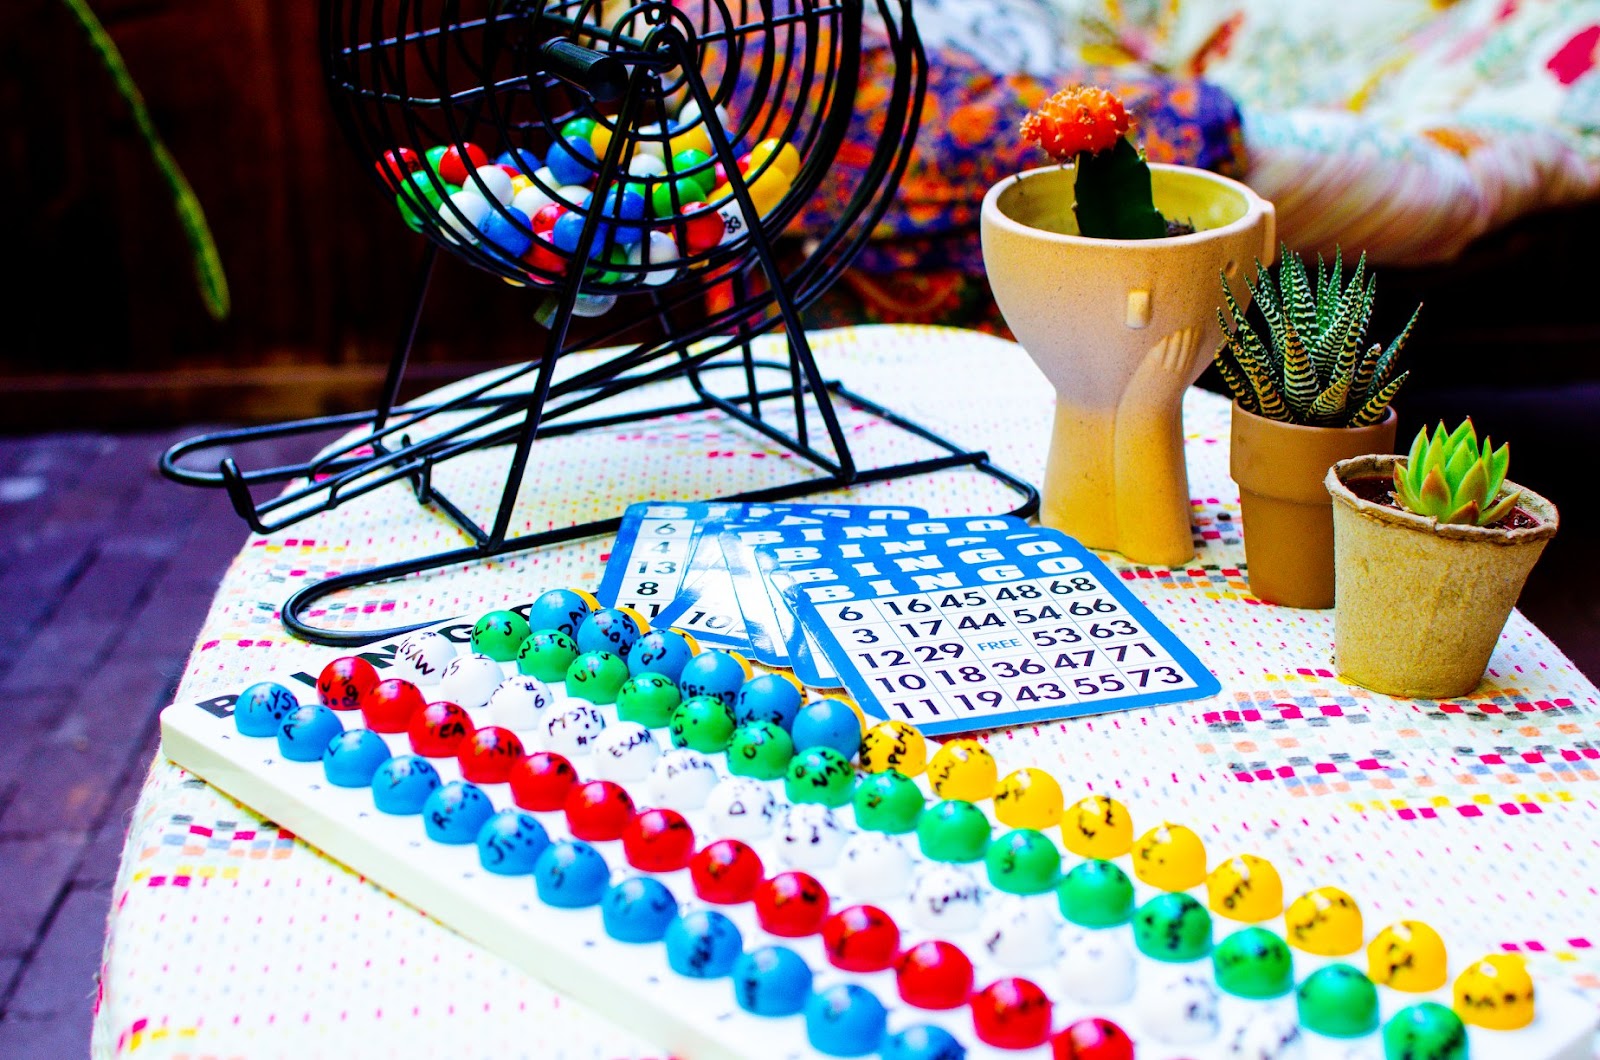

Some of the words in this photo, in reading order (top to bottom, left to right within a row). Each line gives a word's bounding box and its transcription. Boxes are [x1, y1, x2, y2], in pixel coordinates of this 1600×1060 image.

[651, 541, 671, 554] 4
[654, 523, 676, 535] 6
[738, 519, 1009, 546] BINGO
[773, 532, 1040, 563] BING
[637, 561, 677, 574] 13
[788, 540, 1063, 585] BINGO
[803, 556, 1084, 604] BINGO
[636, 582, 659, 595] 8
[838, 606, 864, 621] 6
[883, 598, 932, 616] 16
[940, 591, 987, 608] 45
[995, 584, 1043, 601] 48
[1050, 577, 1097, 595] 68
[688, 611, 733, 629] 10
[852, 628, 879, 643] 3
[900, 619, 943, 638] 17
[958, 612, 1007, 631] 44
[1013, 605, 1063, 624] 54
[1069, 598, 1117, 616] 66
[858, 650, 911, 669] 12
[914, 643, 964, 663] 29
[977, 637, 1023, 652] FREE
[1032, 627, 1082, 647] 53
[1089, 620, 1138, 639] 63
[875, 674, 926, 693] 10
[935, 666, 987, 686] 18
[991, 658, 1046, 678] 36
[1054, 650, 1095, 669] 47
[1105, 642, 1156, 662] 71
[893, 698, 941, 719] 11
[954, 690, 1003, 711] 19
[1016, 683, 1066, 702] 43
[1073, 673, 1125, 695] 55
[1126, 666, 1184, 688] 73
